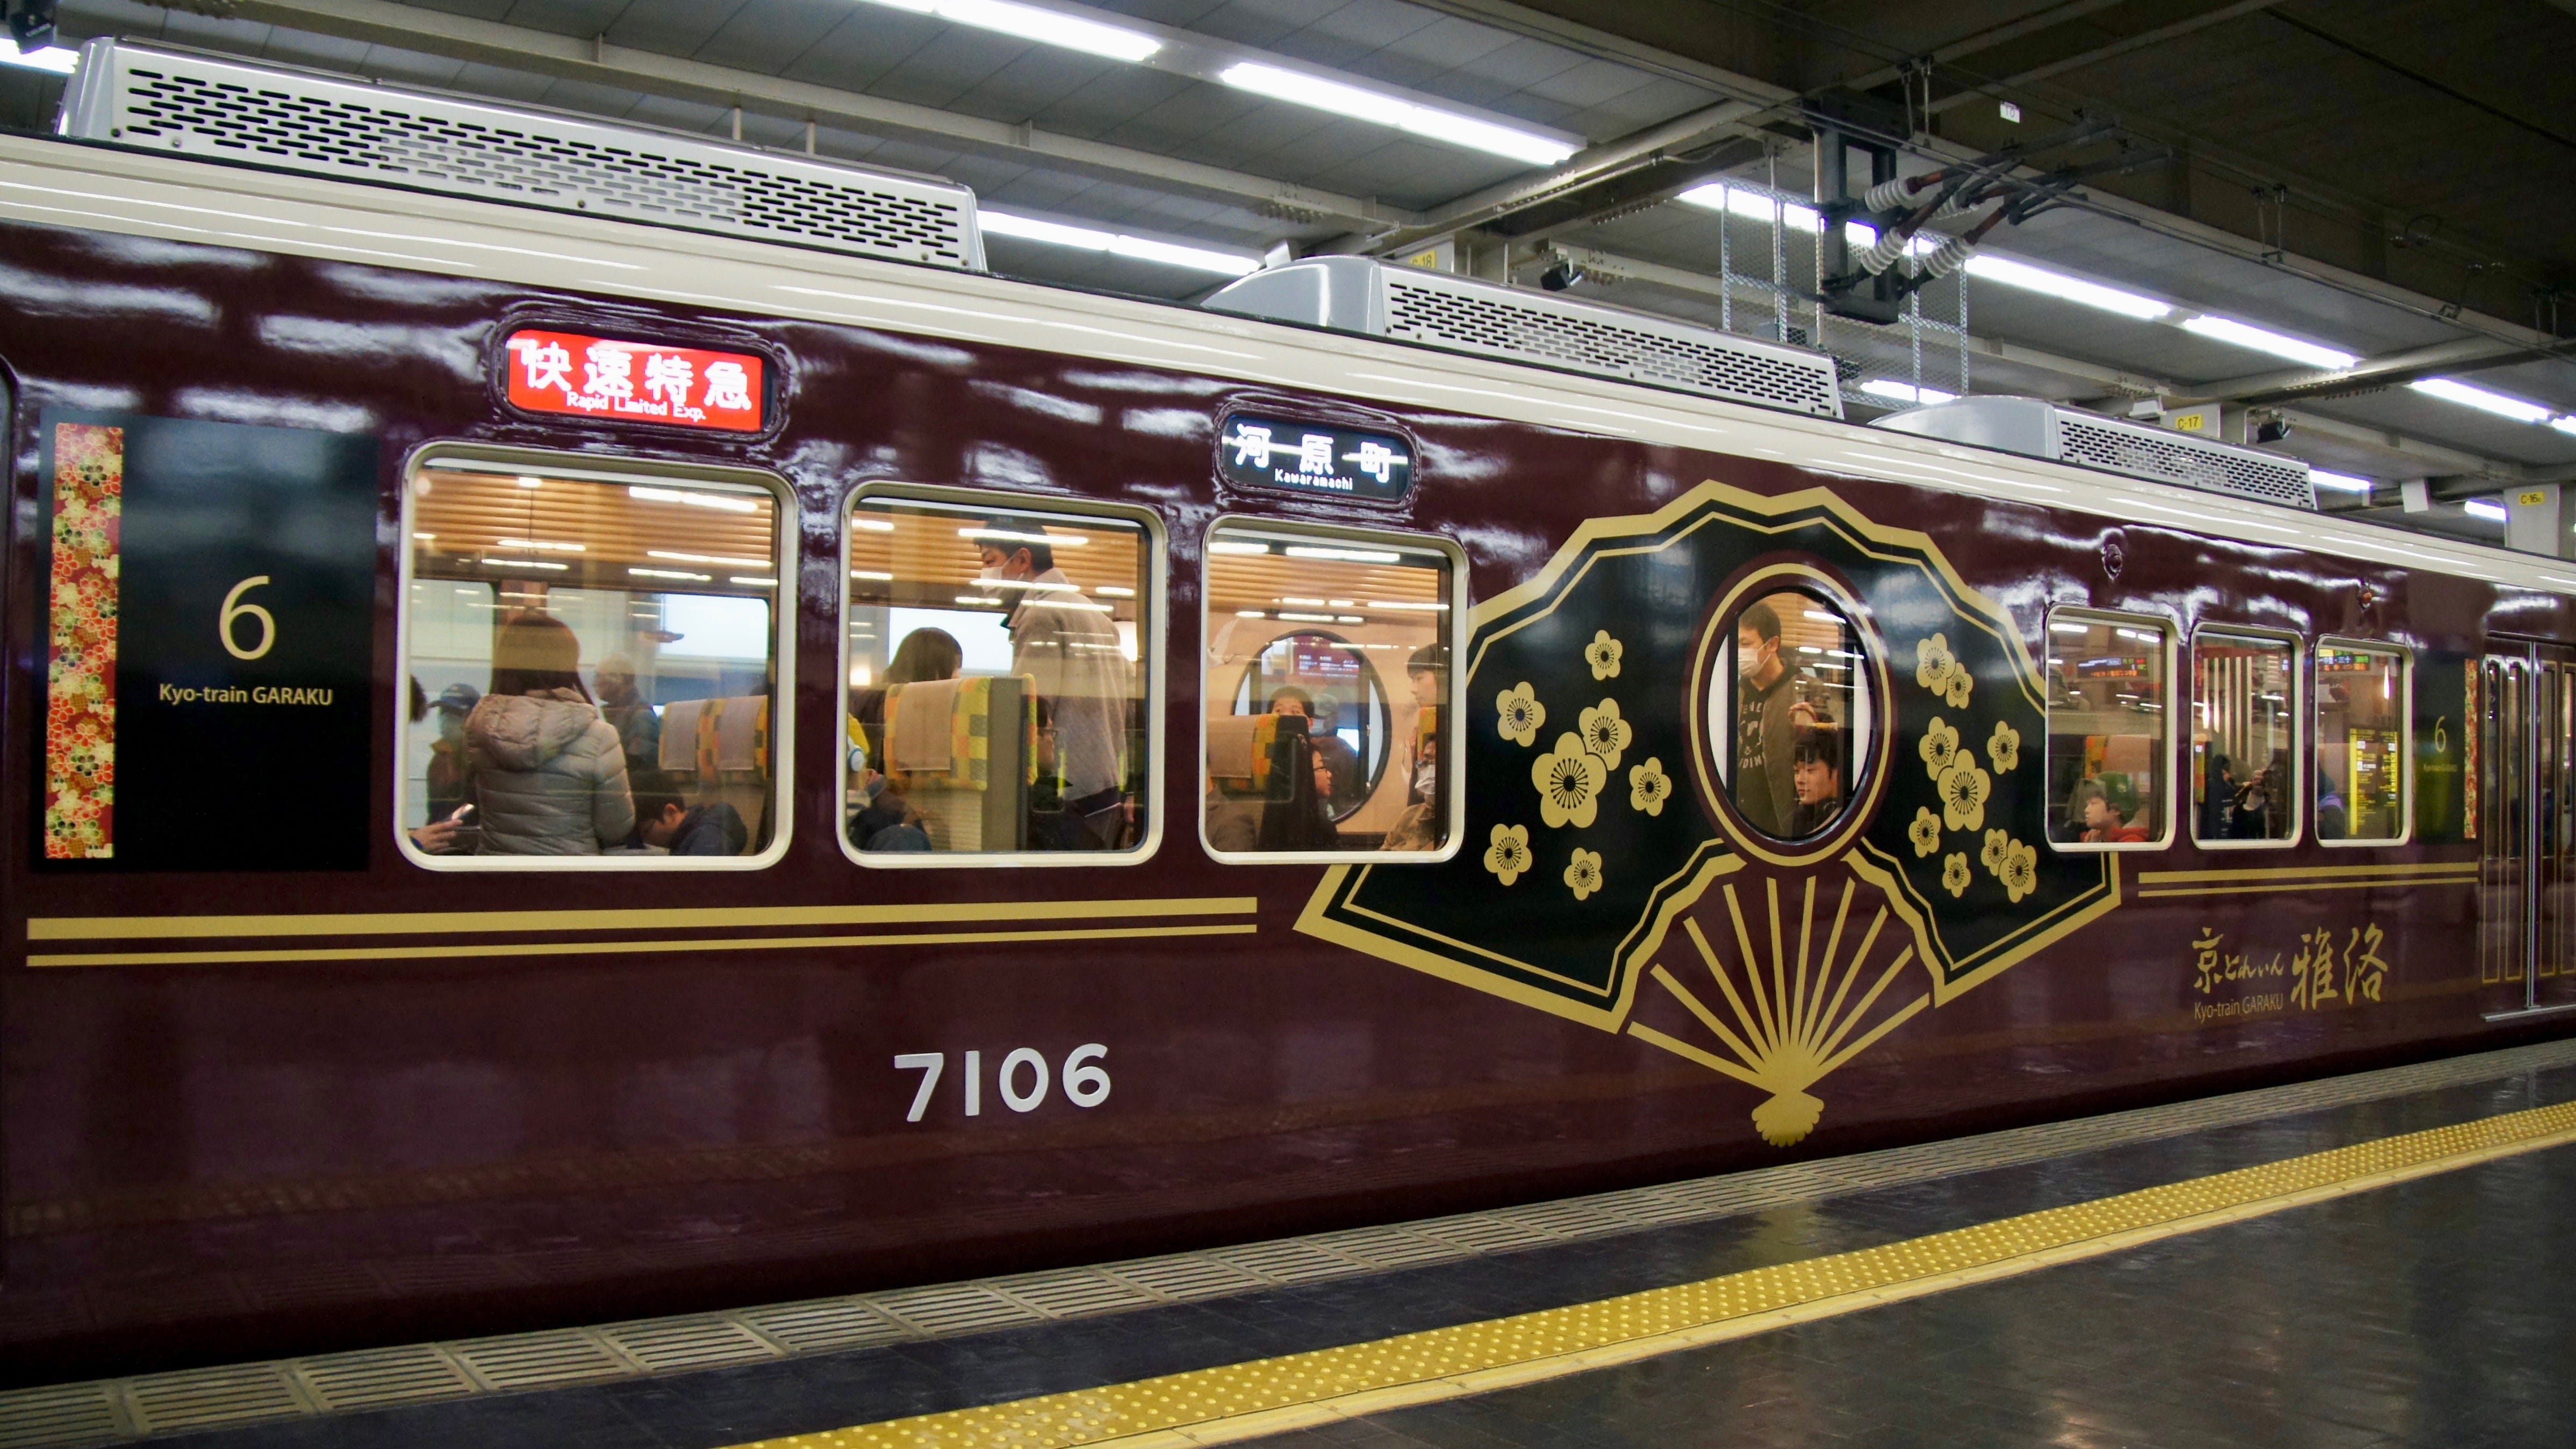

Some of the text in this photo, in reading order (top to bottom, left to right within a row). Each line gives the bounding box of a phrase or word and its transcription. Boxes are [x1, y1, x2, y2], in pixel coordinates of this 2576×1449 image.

[520, 339, 752, 410] 快速特急
[566, 391, 706, 422] Rapid Limited Exp.
[2178, 416, 2199, 429] C-17
[1235, 423, 1391, 483] 河原町
[1275, 468, 1353, 490] Kawaramachi
[219, 575, 275, 660] 6
[159, 684, 334, 706] Kyo-train GARAKU
[2435, 715, 2446, 752] 6
[2194, 993, 2284, 1023] Kyo-train GARAKU
[894, 1043, 1110, 1122] 7106
